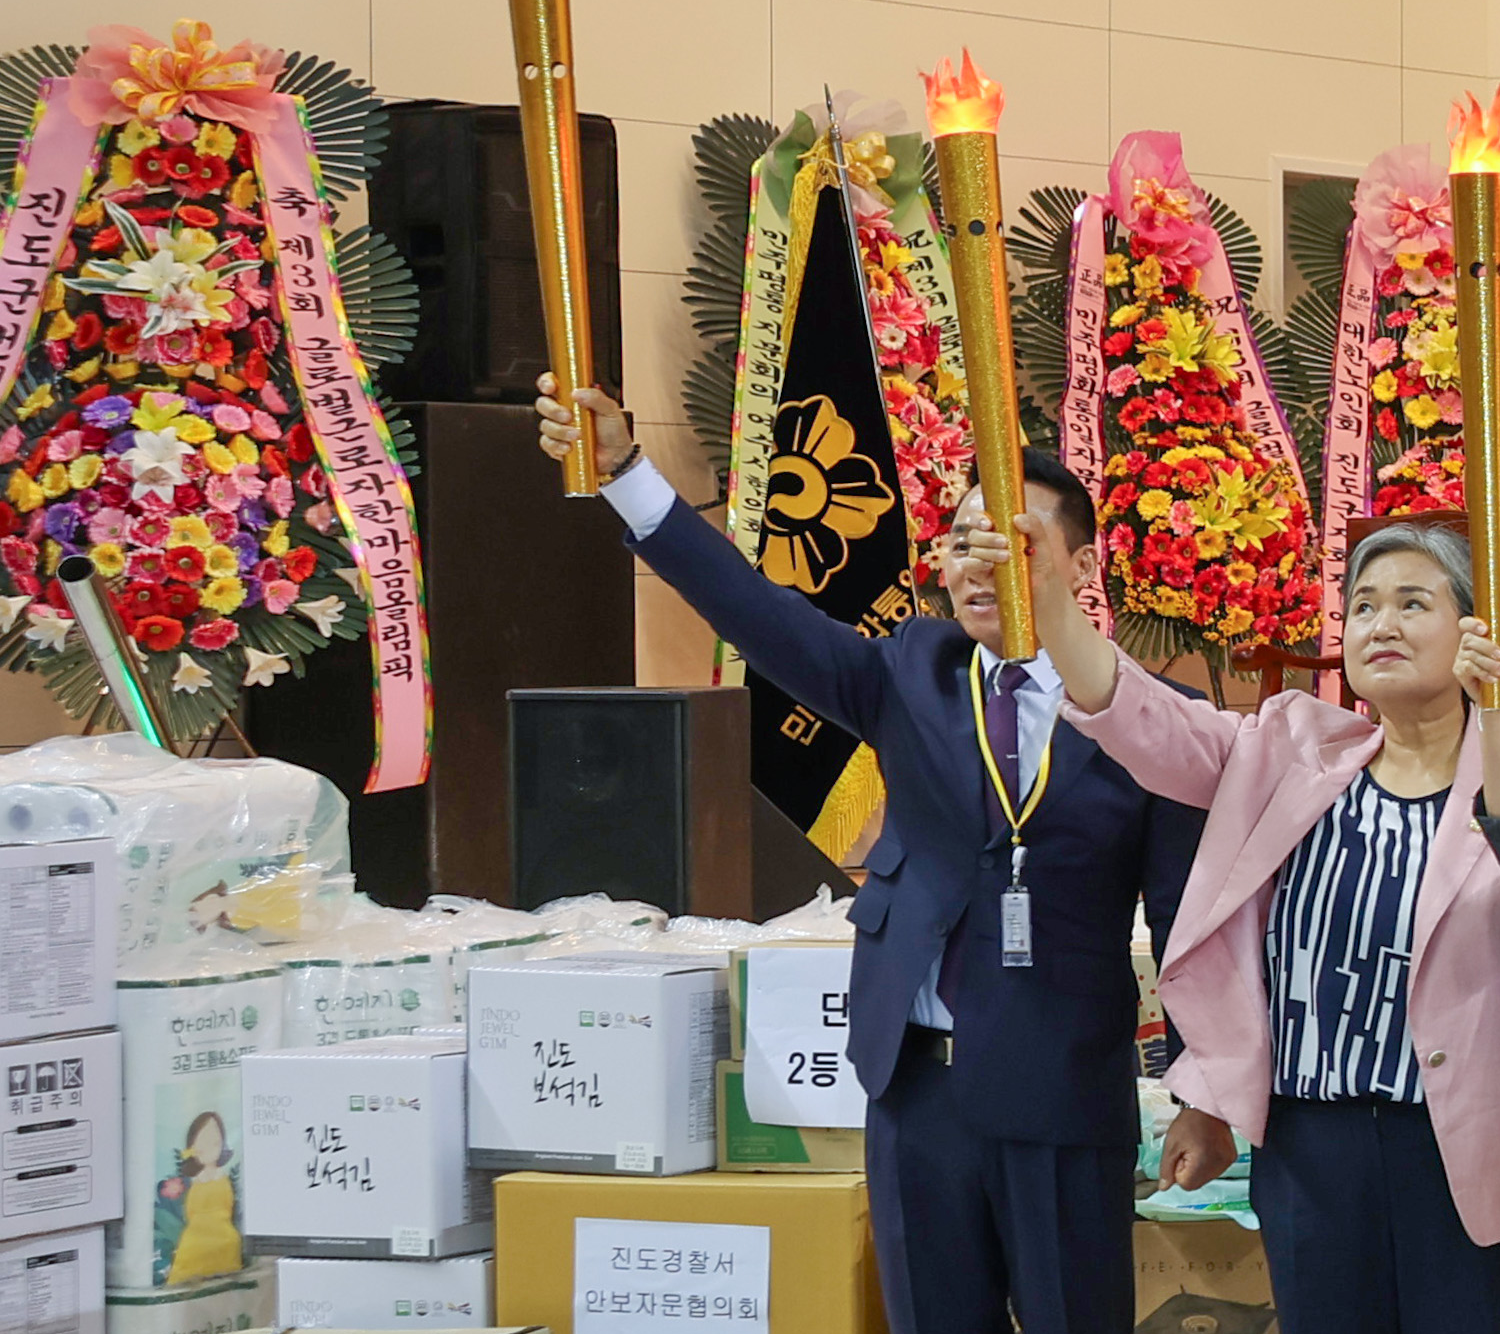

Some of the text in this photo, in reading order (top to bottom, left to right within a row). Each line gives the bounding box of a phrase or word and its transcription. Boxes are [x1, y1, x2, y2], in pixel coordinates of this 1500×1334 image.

[270, 186, 316, 219] 축
[277, 233, 325, 320] 제3회
[533, 1038, 577, 1068] 진도
[786, 1050, 840, 1088] 2등
[533, 1070, 605, 1108] 보석김
[304, 1124, 348, 1154] 진도
[306, 1155, 376, 1192] 보석김
[610, 1245, 736, 1277] 진도경찰서
[583, 1288, 761, 1322] 안보자문협의회
